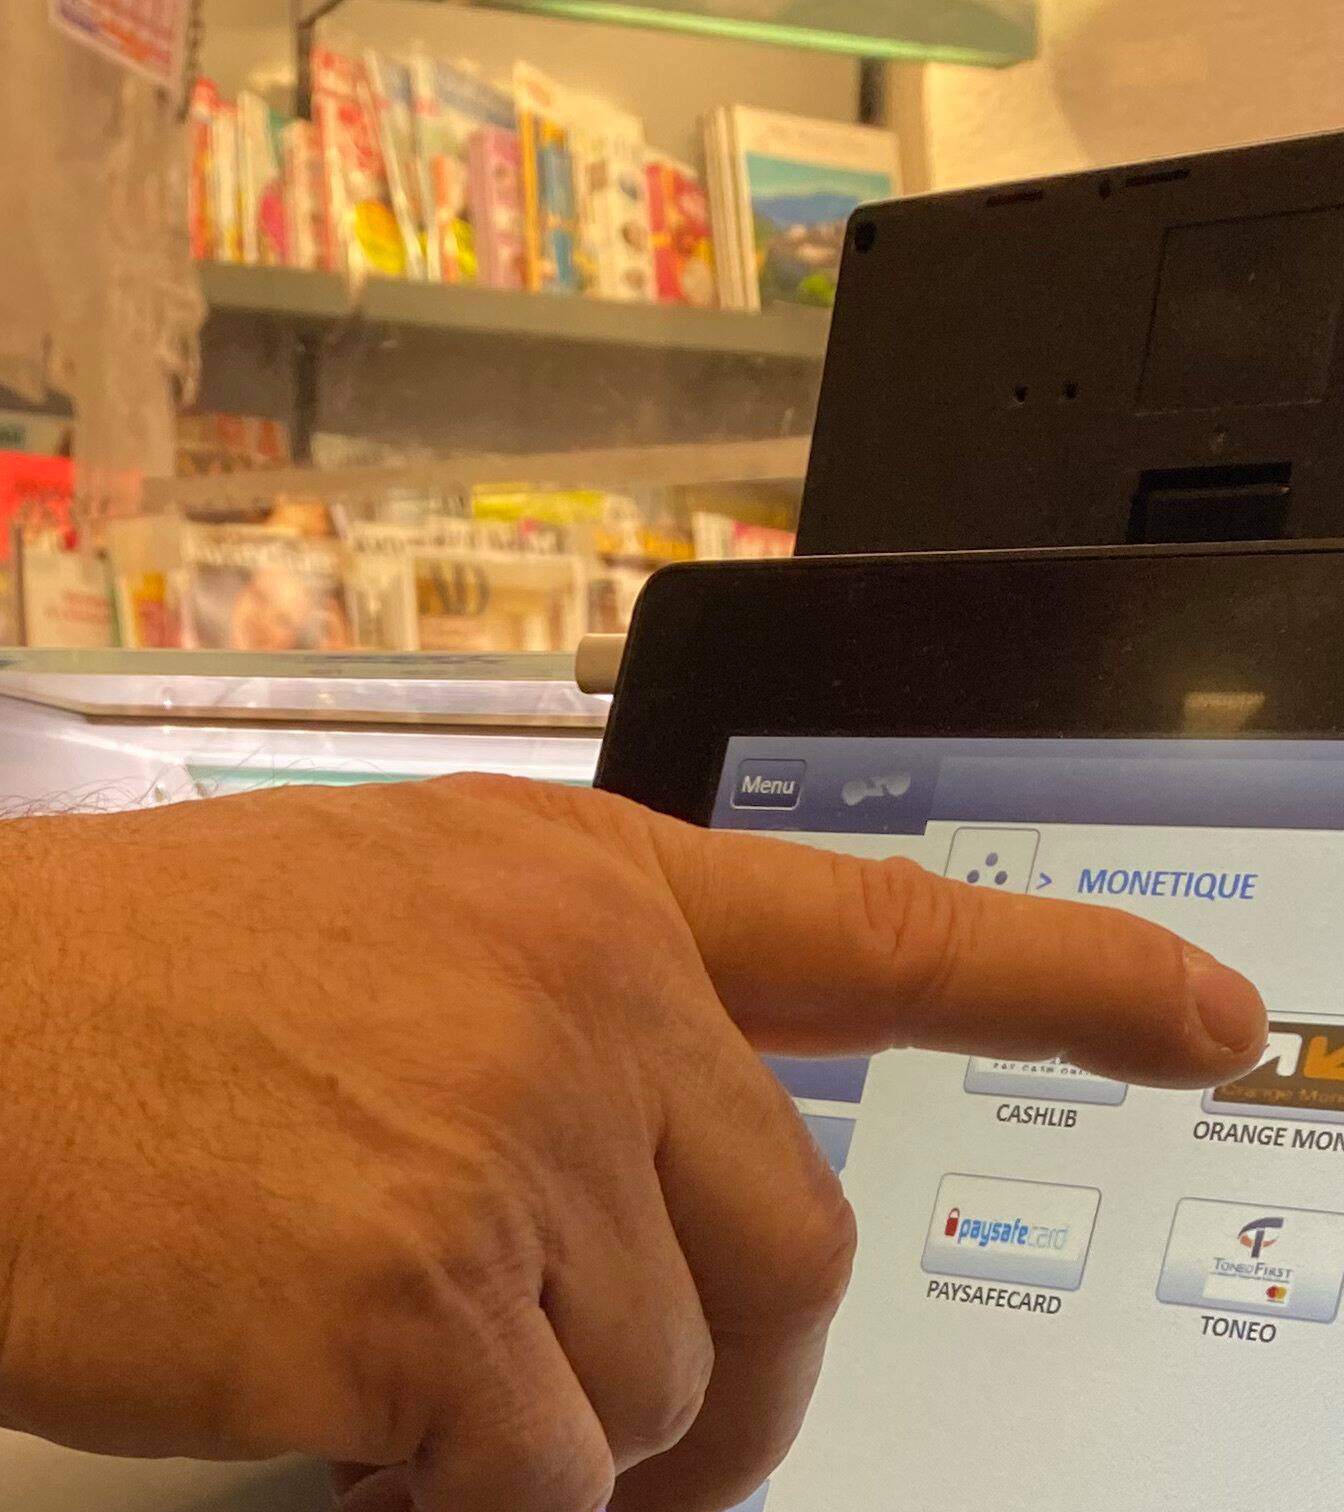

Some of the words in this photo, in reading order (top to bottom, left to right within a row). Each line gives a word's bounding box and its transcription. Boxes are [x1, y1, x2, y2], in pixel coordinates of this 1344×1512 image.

[741, 774, 795, 797] Menu
[1077, 868, 1258, 900] MONETIQUE
[996, 1104, 1078, 1128] CASHLIB
[1193, 1120, 1287, 1147] ORANGE
[958, 1217, 1068, 1250] paysafecard
[926, 1280, 1061, 1315] PAYSAFECARD
[1200, 1315, 1277, 1343] TONEO
